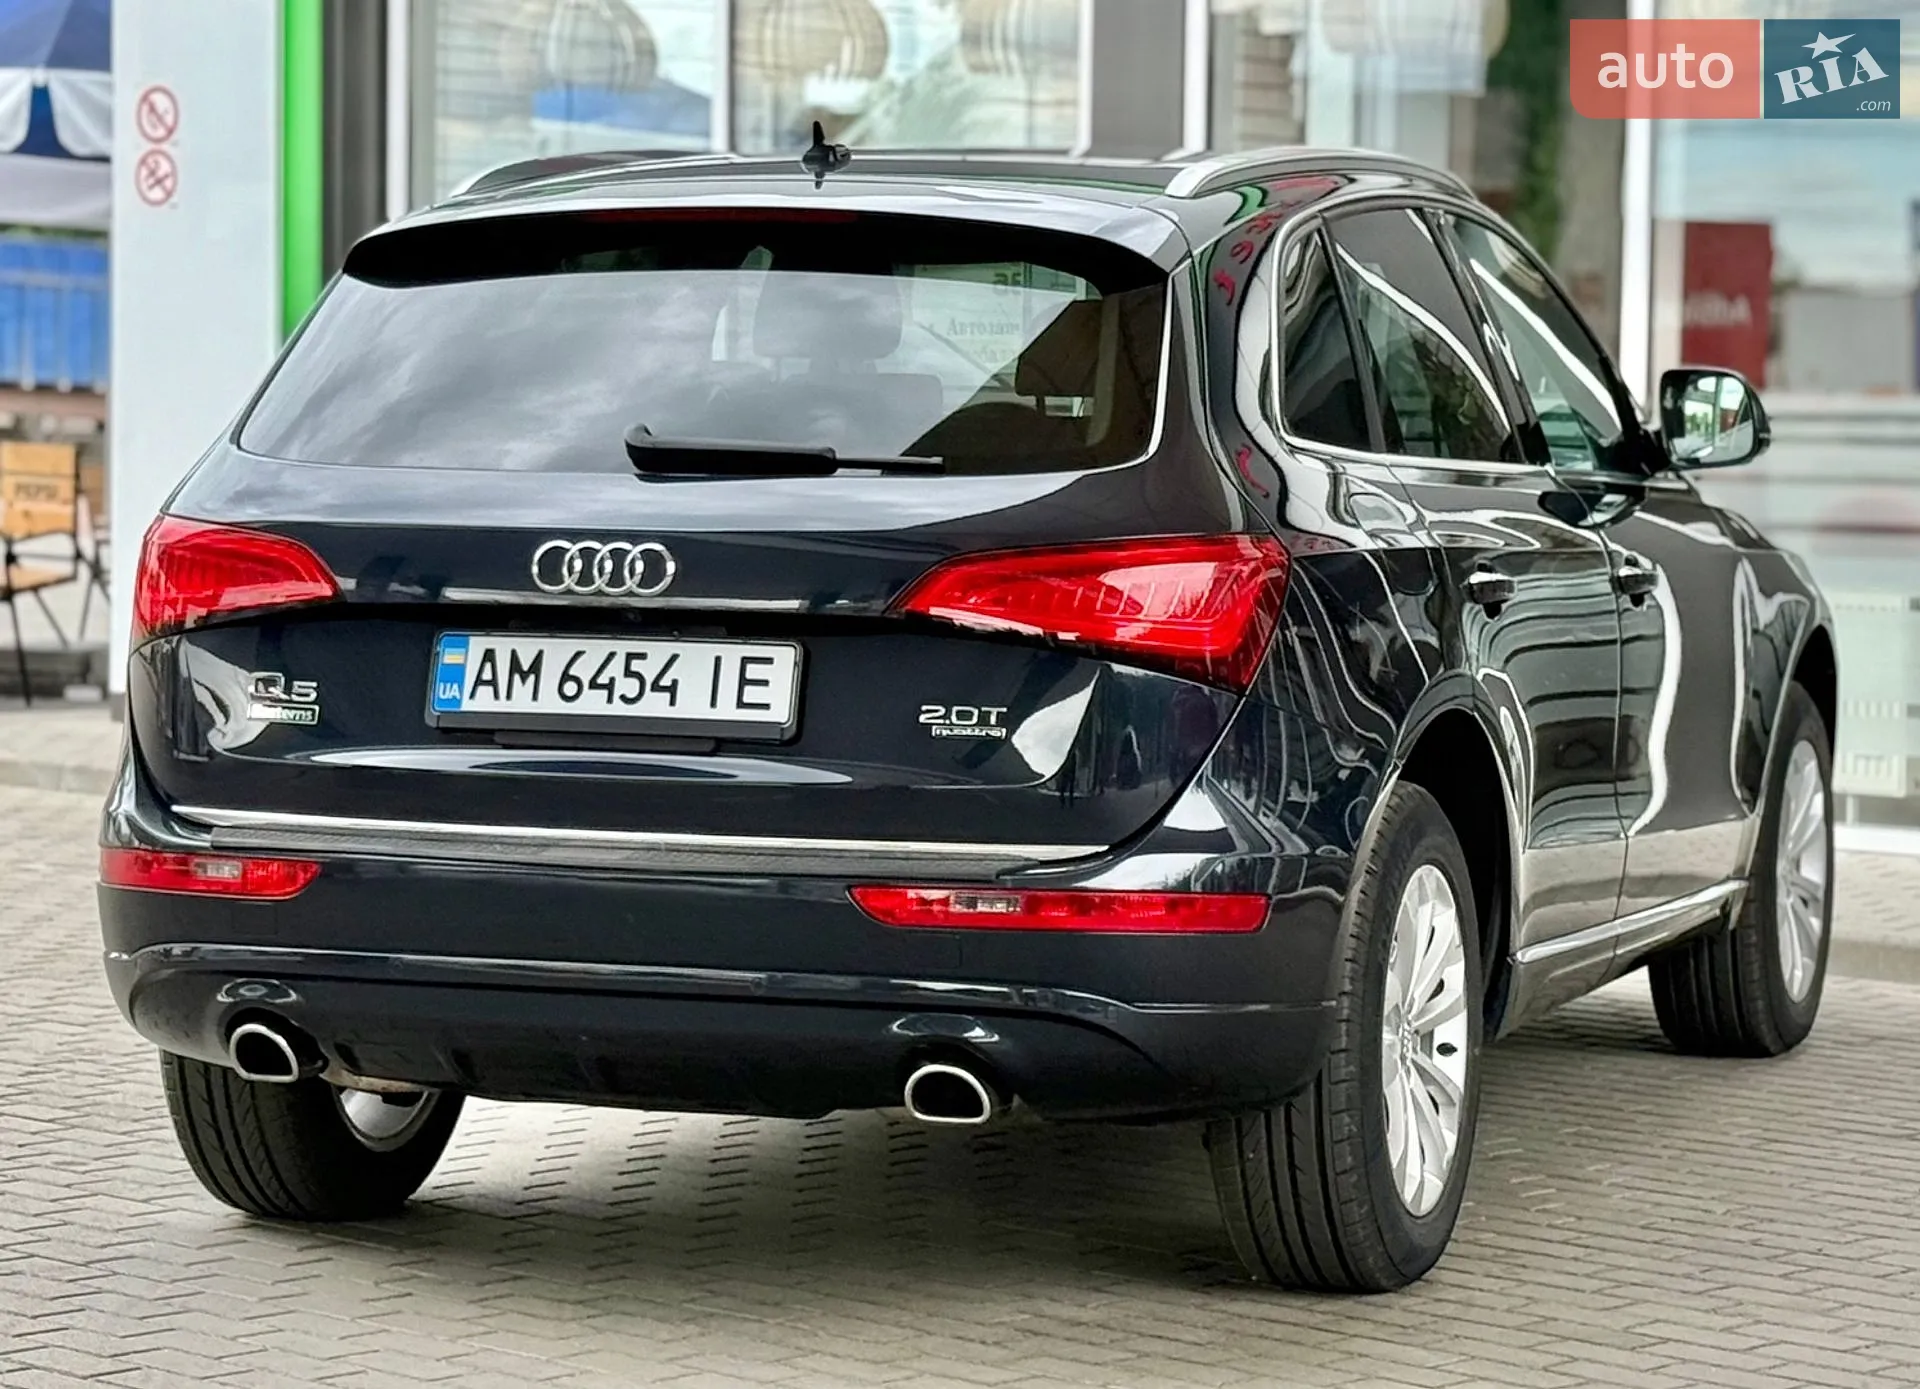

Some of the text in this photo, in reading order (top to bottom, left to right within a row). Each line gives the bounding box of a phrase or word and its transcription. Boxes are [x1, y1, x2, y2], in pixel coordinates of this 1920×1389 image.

[247, 672, 318, 703] Q5
[439, 682, 461, 700] UA
[469, 648, 776, 711] AM 6454 IE
[918, 705, 1008, 726] 2.0T
